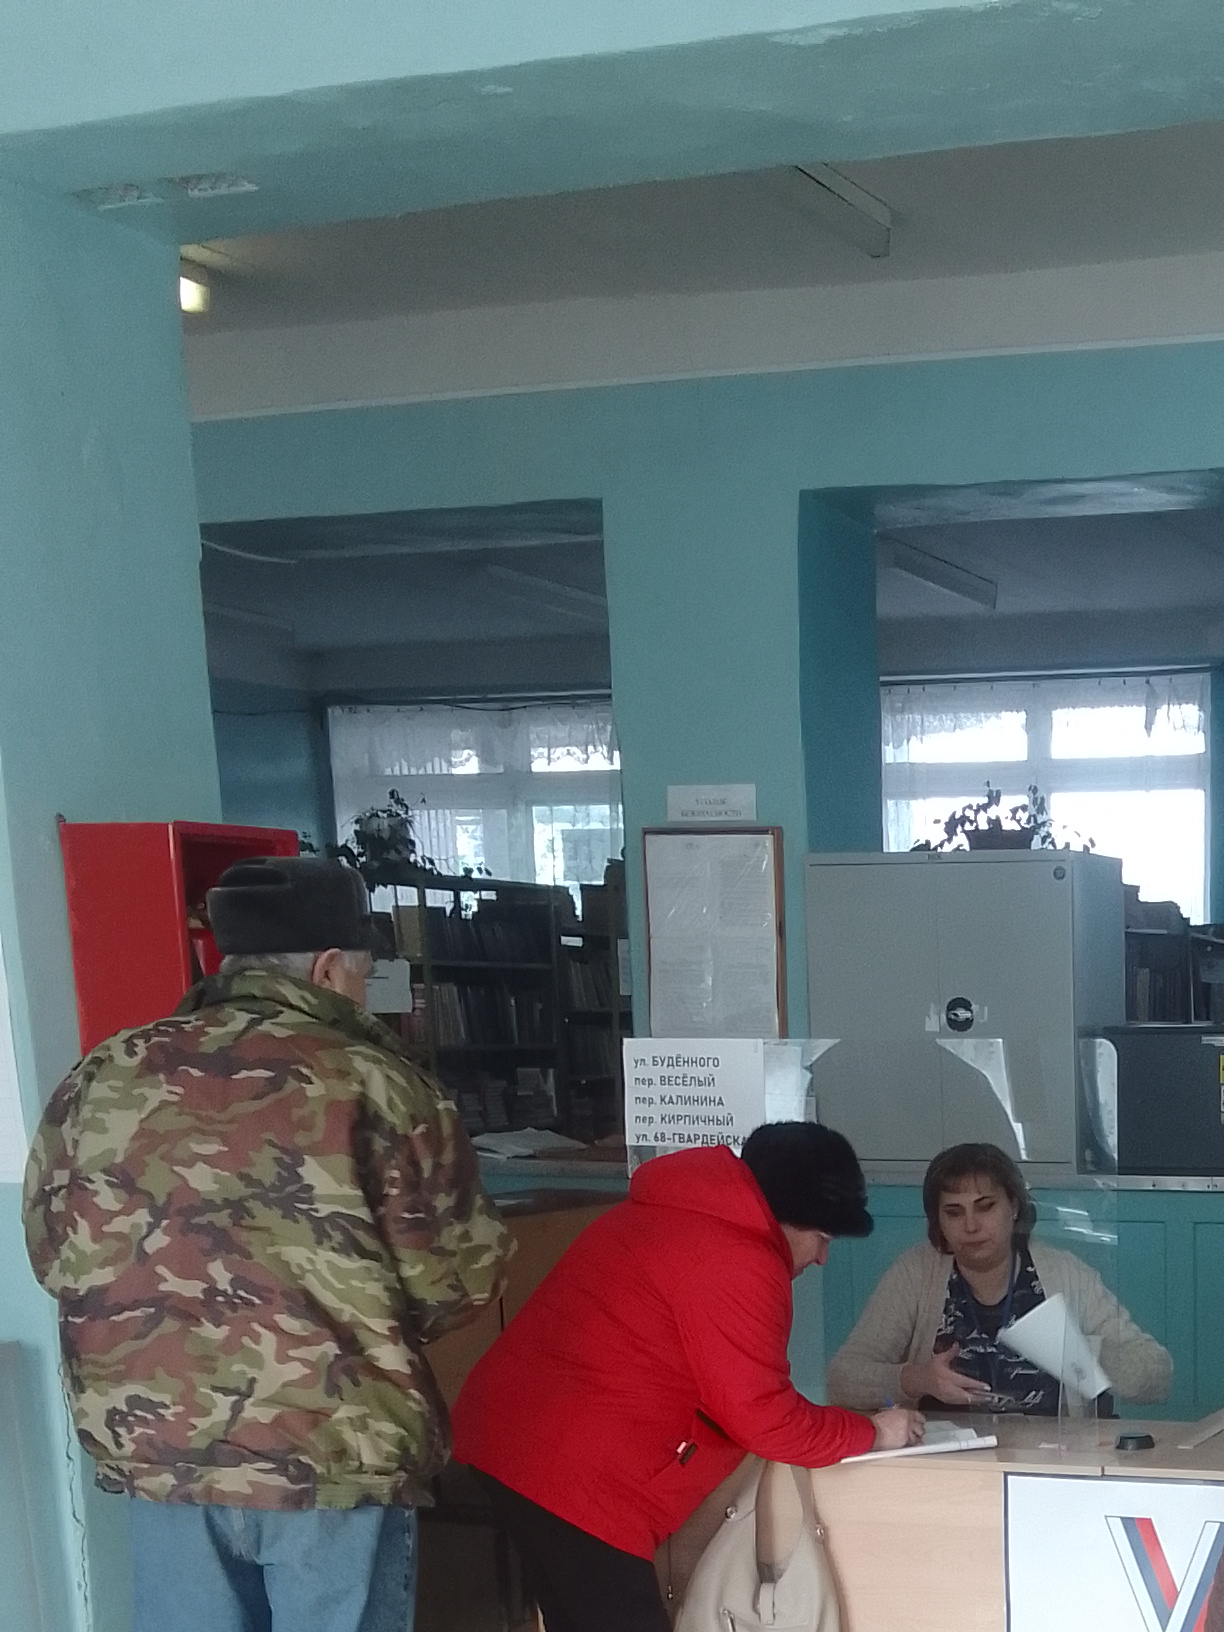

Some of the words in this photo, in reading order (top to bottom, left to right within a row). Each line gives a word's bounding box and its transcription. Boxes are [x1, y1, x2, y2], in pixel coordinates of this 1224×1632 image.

[633, 1058, 649, 1069] ул.
[651, 1054, 720, 1069] БУДЁННОГО
[634, 1076, 656, 1088] пер.
[659, 1073, 716, 1088] ВЕСЁЛЫЙ
[634, 1096, 657, 1108] пер.
[659, 1094, 725, 1107] КАЛИНИНА
[634, 1115, 657, 1127] пер.
[660, 1112, 734, 1127] КИРПИЧНЫЙ
[635, 1133, 651, 1144] ул.
[653, 1131, 747, 1147] 68-ГВАРДЕЙСКА
